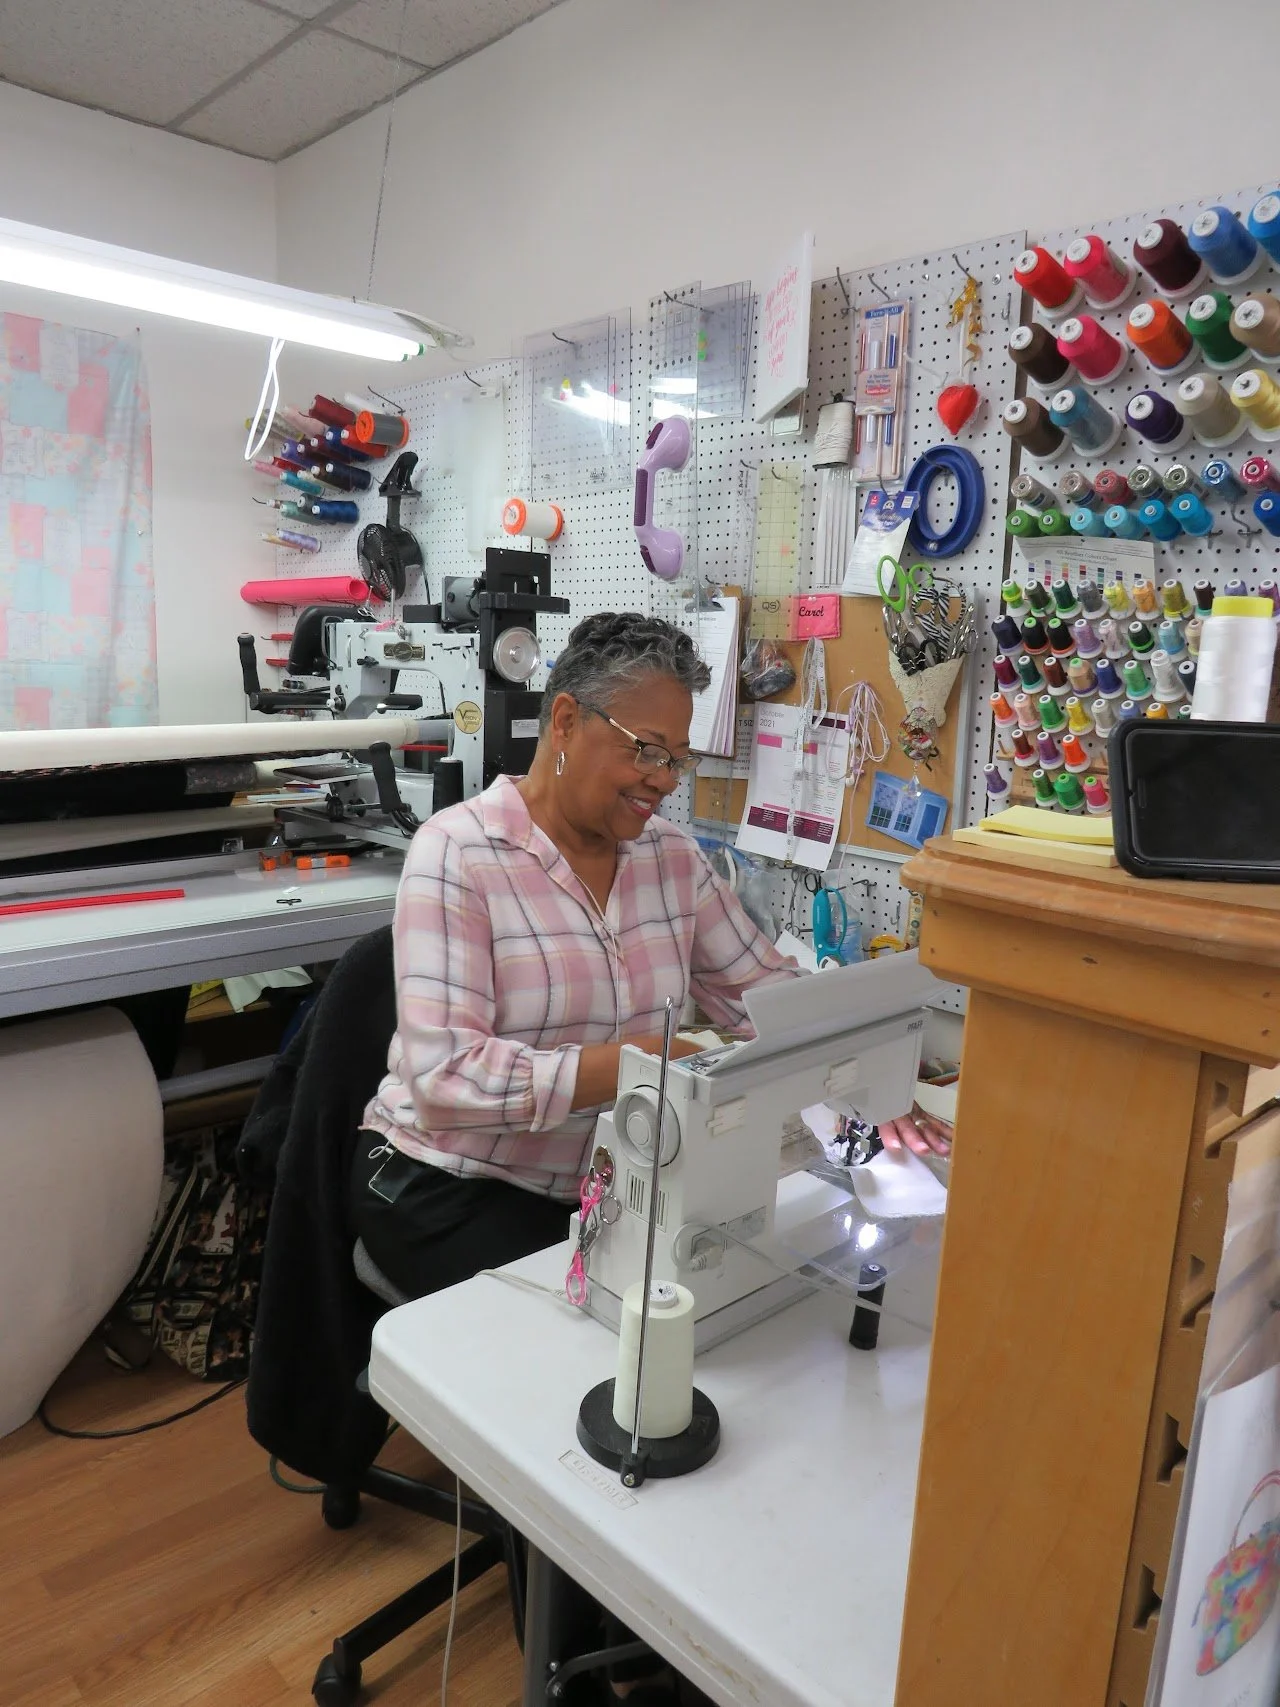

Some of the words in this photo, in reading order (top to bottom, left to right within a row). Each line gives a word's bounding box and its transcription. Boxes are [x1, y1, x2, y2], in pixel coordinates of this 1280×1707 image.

[798, 605, 825, 617] Carol
[744, 719, 754, 727] SIZ
[759, 718, 776, 728] 2021
[907, 1020, 923, 1032] PFAFF
